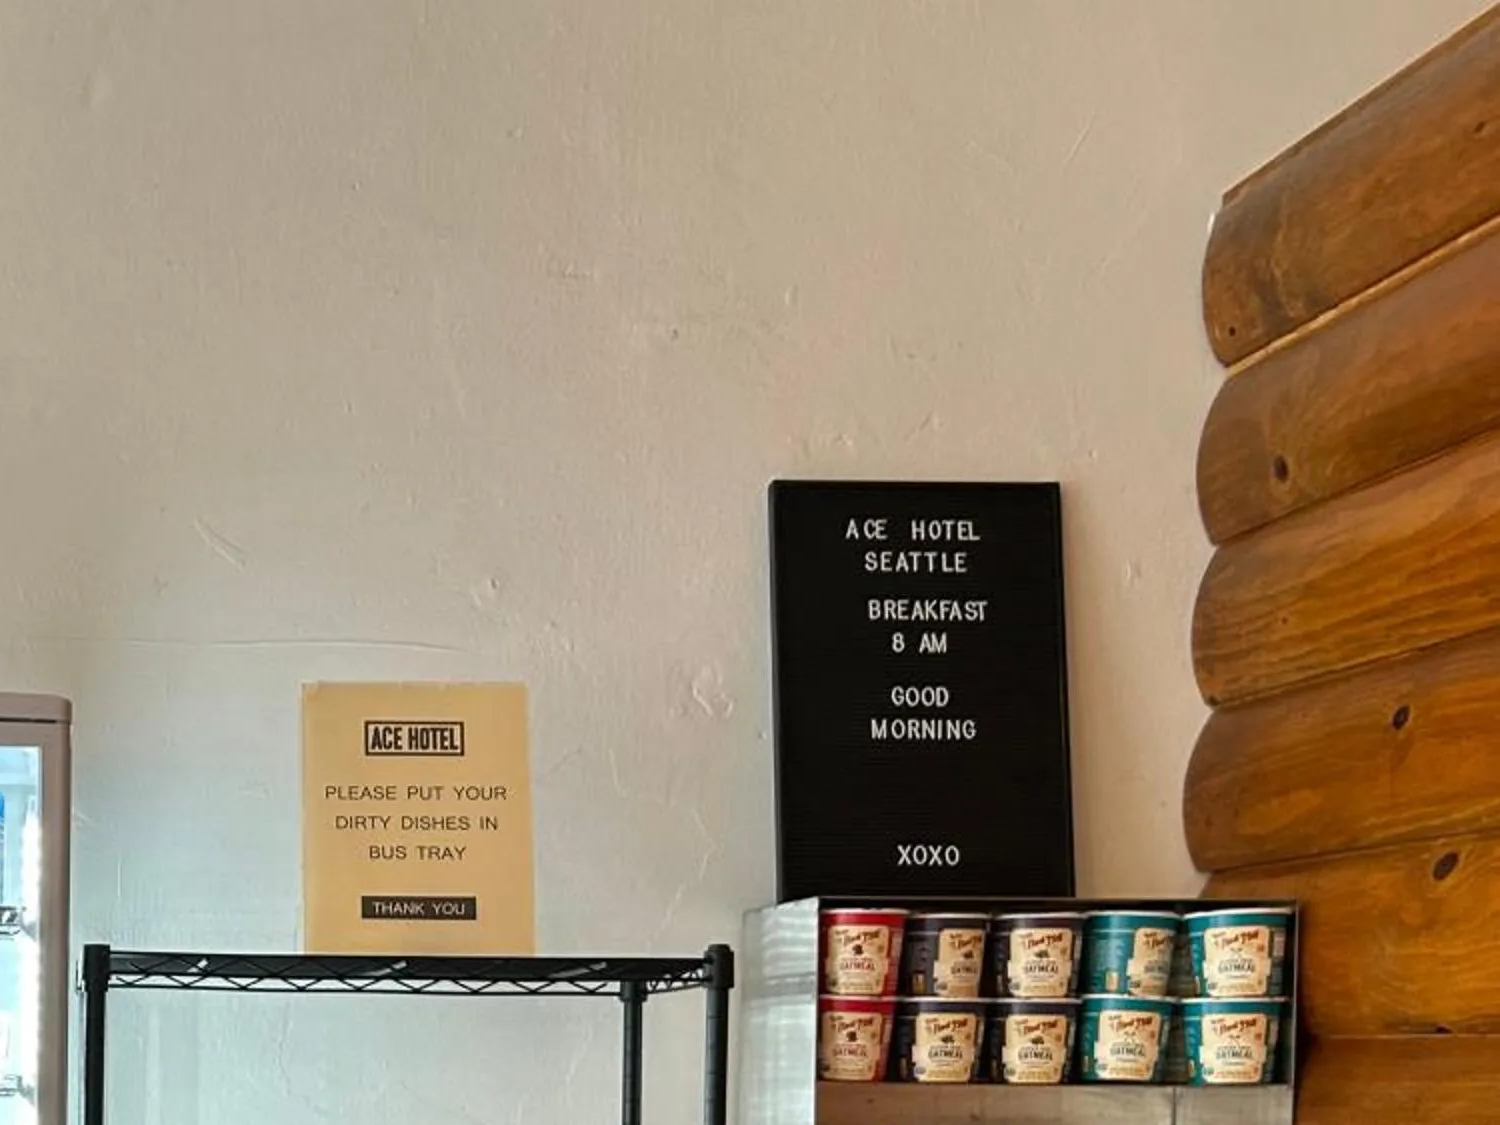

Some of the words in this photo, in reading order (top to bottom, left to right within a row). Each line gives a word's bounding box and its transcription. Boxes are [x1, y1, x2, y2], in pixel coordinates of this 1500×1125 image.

[845, 518, 888, 540] ACE
[910, 520, 981, 542] HOTEL
[863, 551, 968, 573] SEATTLE
[867, 599, 988, 621] BREAKFAST
[891, 632, 905, 653] 8
[918, 632, 948, 653] AM
[890, 686, 949, 707] GOOD
[370, 726, 403, 751] ACE
[407, 726, 459, 751] HOTEL
[870, 718, 977, 740] MORNING
[324, 785, 397, 801] PLEASE
[406, 785, 445, 801] PUT
[453, 785, 508, 801] YOUR
[334, 815, 391, 830] DIRTY
[400, 815, 471, 831] DISHES
[479, 816, 499, 831] IN
[368, 845, 408, 861] BUS
[416, 845, 467, 861] TRAY
[896, 844, 960, 866] XOXO
[372, 901, 425, 915] THANK
[431, 902, 466, 915] YOU
